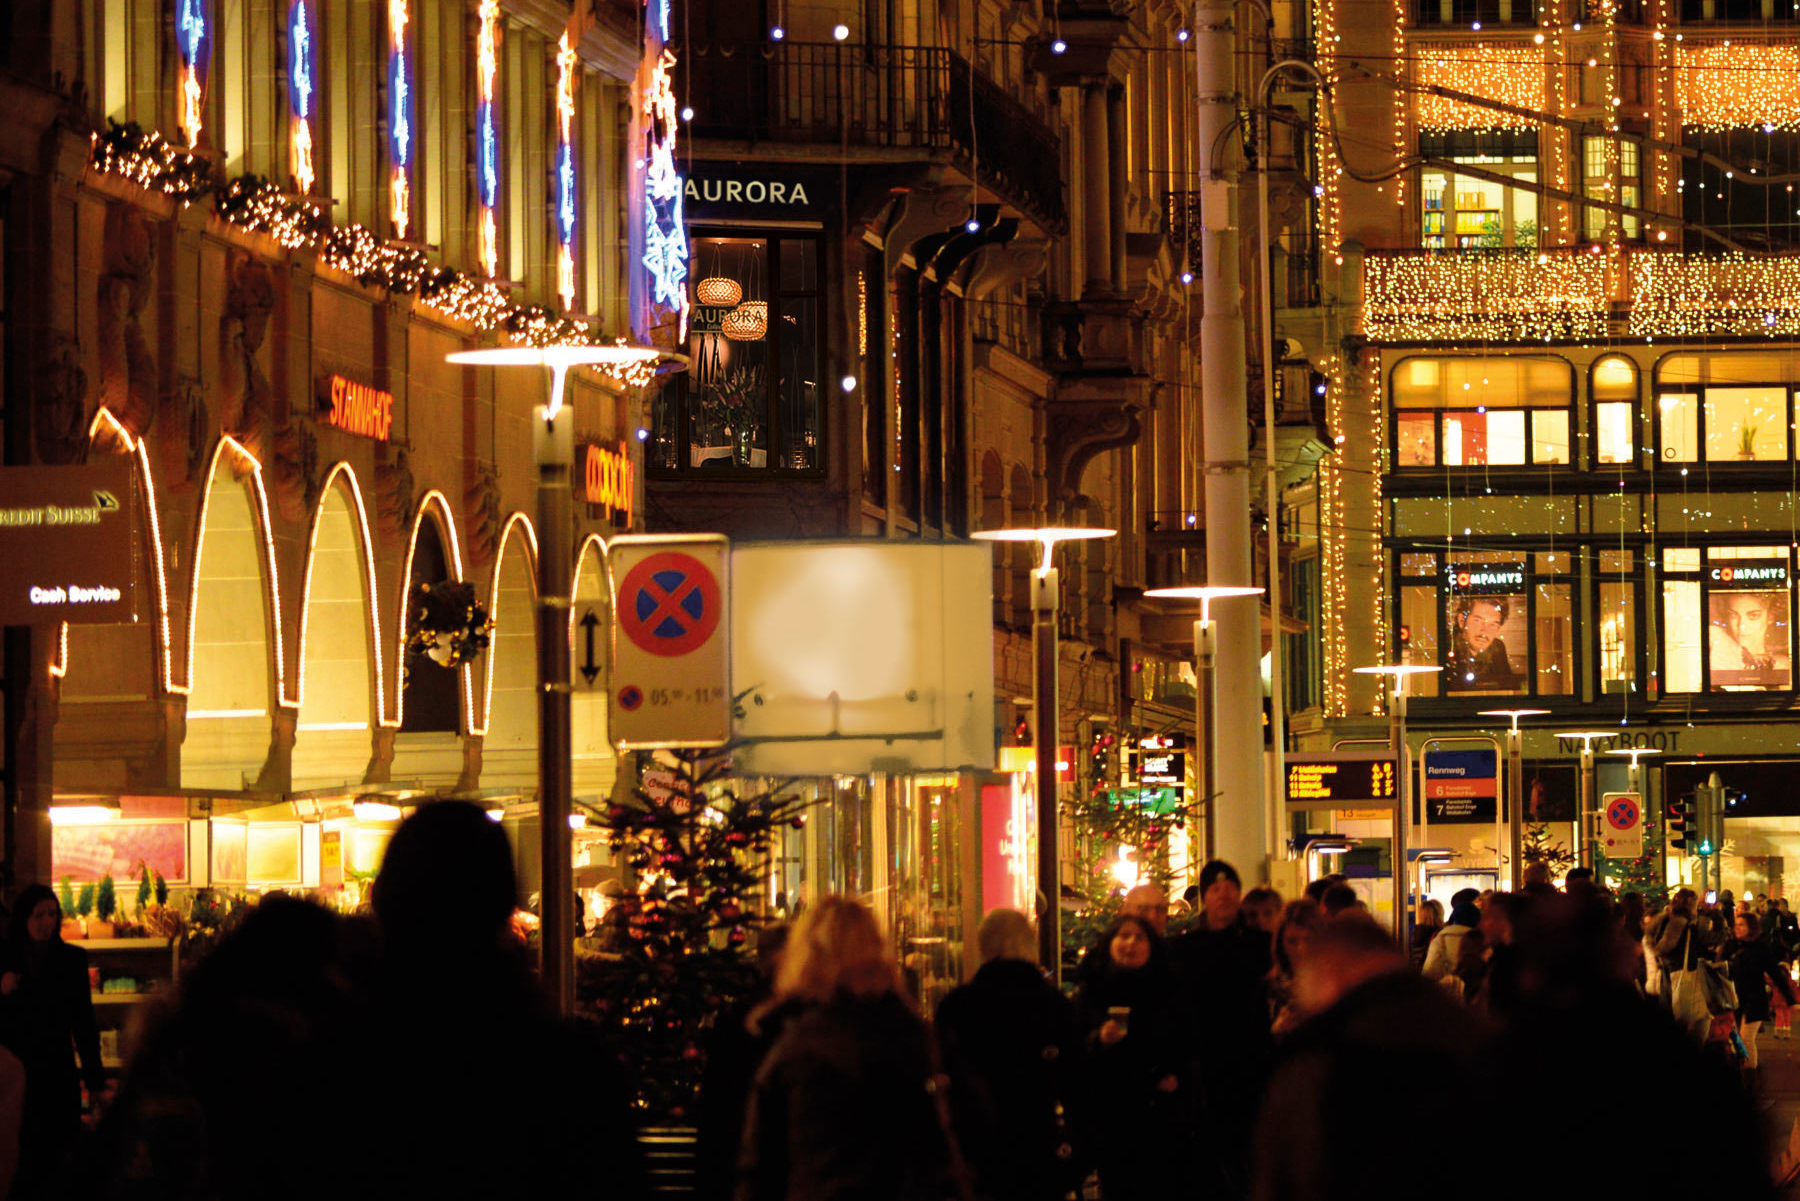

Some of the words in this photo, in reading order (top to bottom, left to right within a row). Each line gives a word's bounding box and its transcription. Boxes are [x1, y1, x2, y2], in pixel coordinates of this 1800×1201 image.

[685, 179, 809, 205] AURORA
[693, 309, 763, 324] AURORA
[1448, 572, 1523, 586] COMPANYS
[1711, 567, 1786, 581] COMPANYS
[30, 585, 67, 604] Cash
[68, 584, 121, 603] Service
[1428, 766, 1466, 776] Rennweg
[1436, 785, 1444, 796] 6
[1436, 804, 1444, 816] 7
